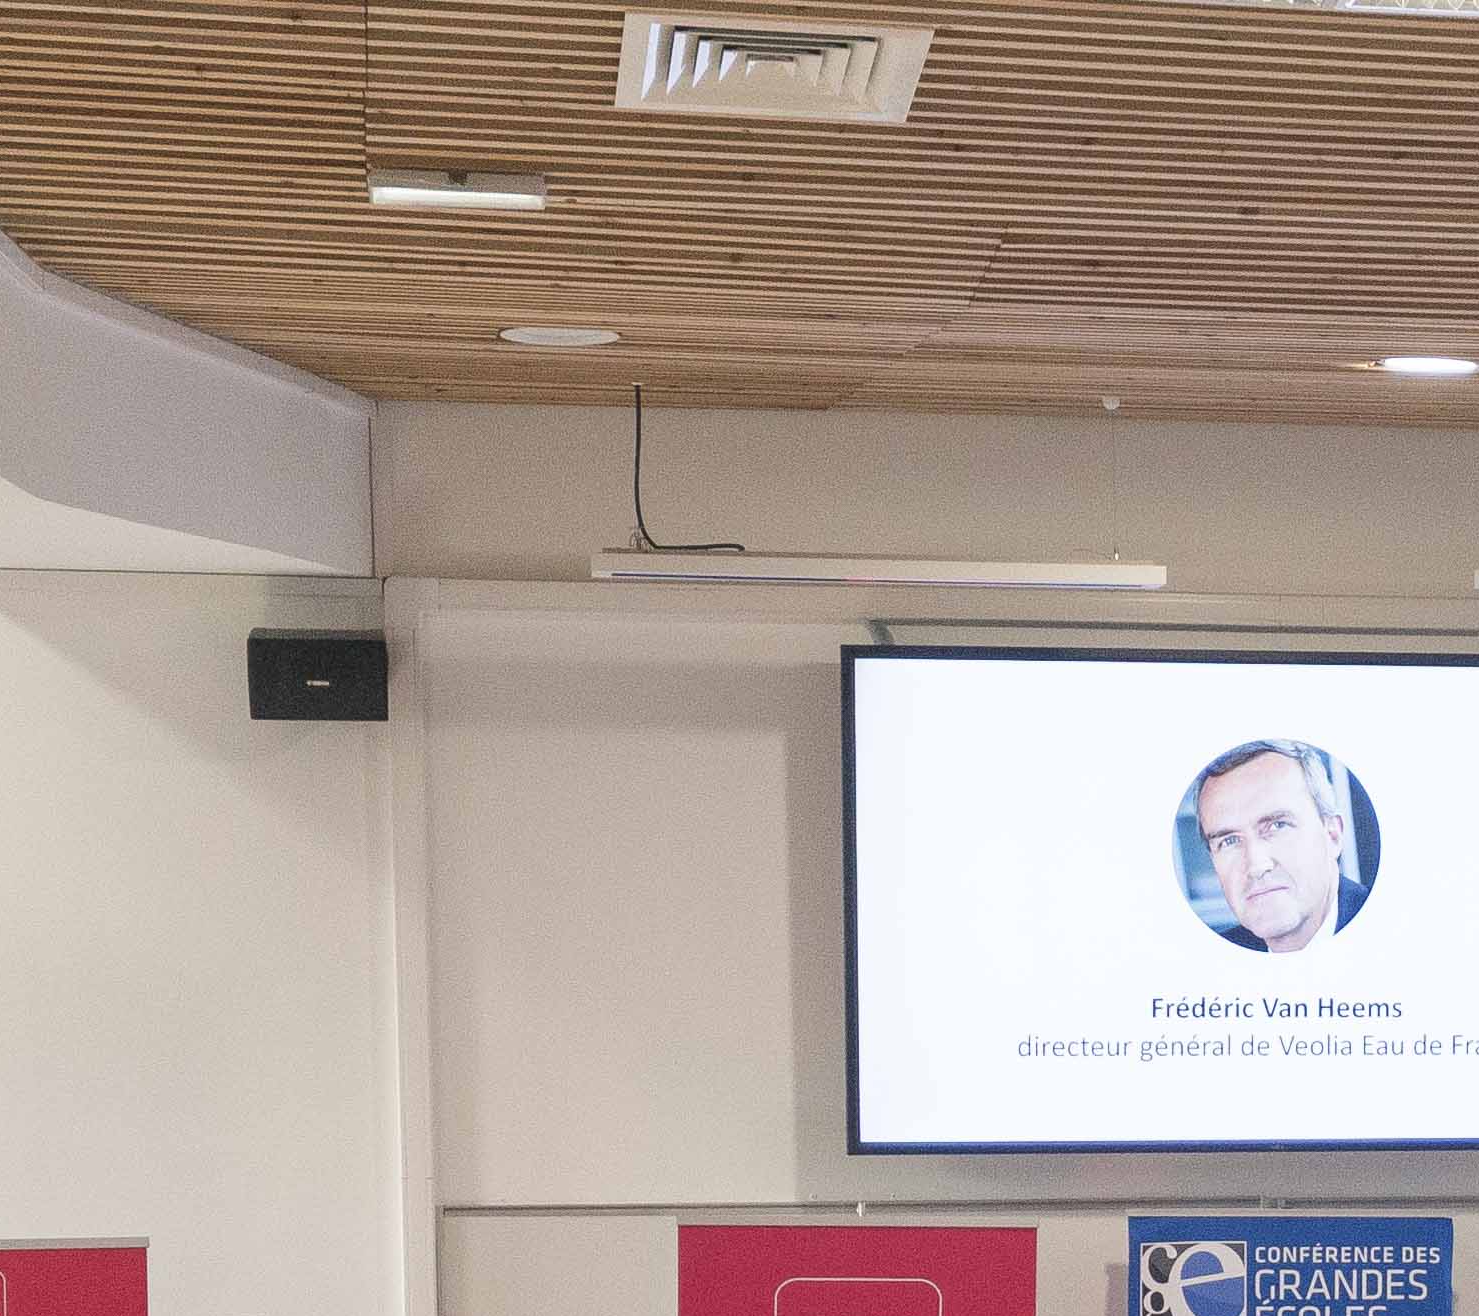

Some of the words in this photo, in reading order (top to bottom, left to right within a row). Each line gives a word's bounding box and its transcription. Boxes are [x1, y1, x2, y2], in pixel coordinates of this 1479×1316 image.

[1151, 997, 1254, 1019] Frédéric
[1262, 998, 1308, 1019] Van
[1317, 998, 1403, 1019] Heems
[1018, 1035, 1132, 1058] directeur
[1139, 1034, 1232, 1063] général
[1240, 1035, 1270, 1058] de
[1279, 1035, 1353, 1058] Veolia
[1363, 1035, 1405, 1058] Eau
[1413, 1035, 1442, 1058] de
[1255, 1244, 1394, 1264] CONFÉRENCE
[1401, 1247, 1440, 1264] DES
[1255, 1269, 1428, 1300] GRANDES
